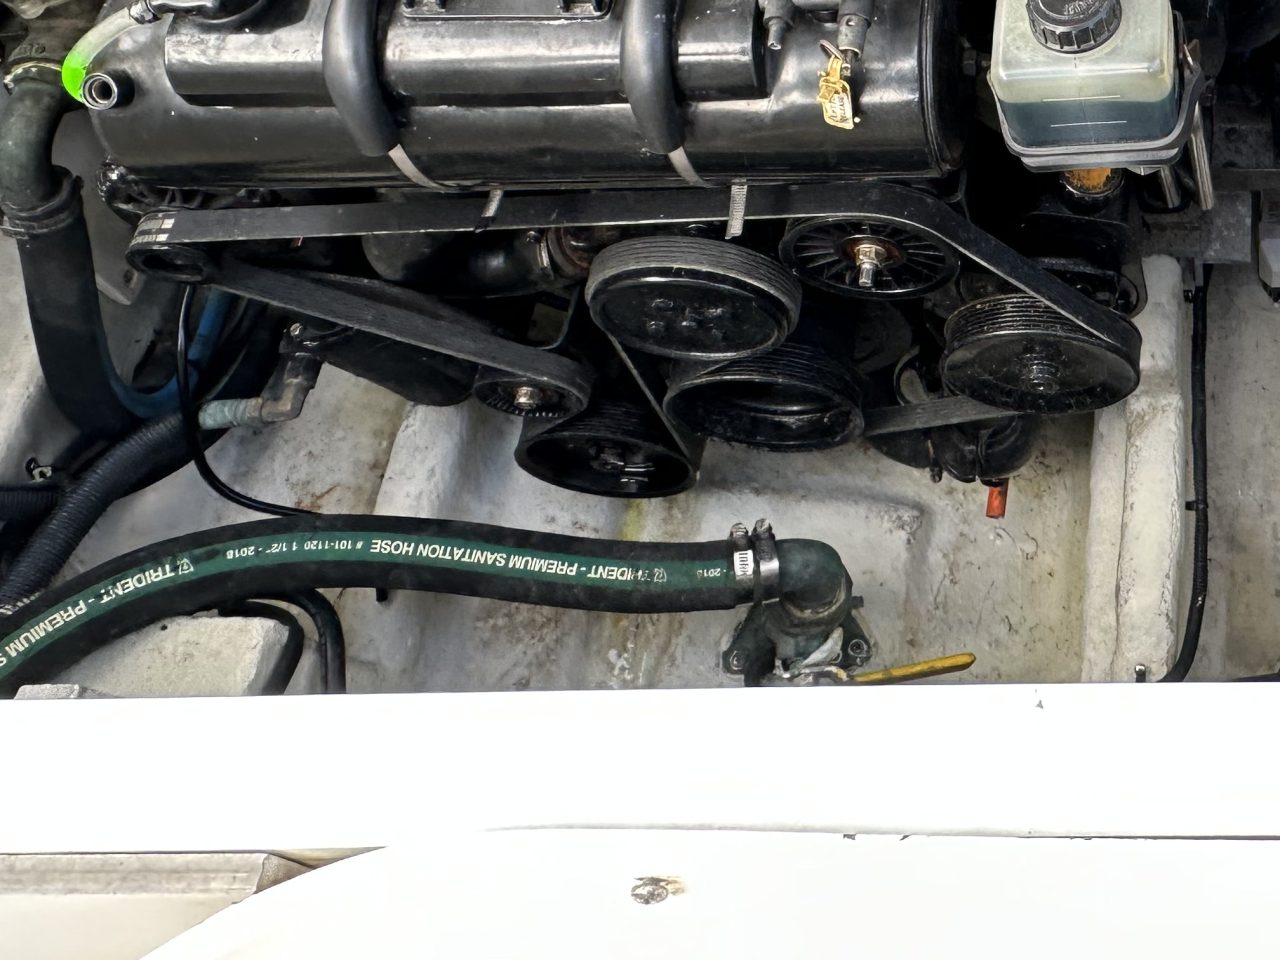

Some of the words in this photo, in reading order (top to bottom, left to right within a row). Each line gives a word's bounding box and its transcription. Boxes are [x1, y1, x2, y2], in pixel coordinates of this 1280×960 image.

[304, 540, 353, 550] 101-1120
[370, 539, 415, 555] HOSE
[417, 542, 507, 567] SANITATION
[510, 554, 578, 576] PREMIUM
[99, 563, 176, 604] TRIDENT
[4, 599, 88, 658] PREMIUM
